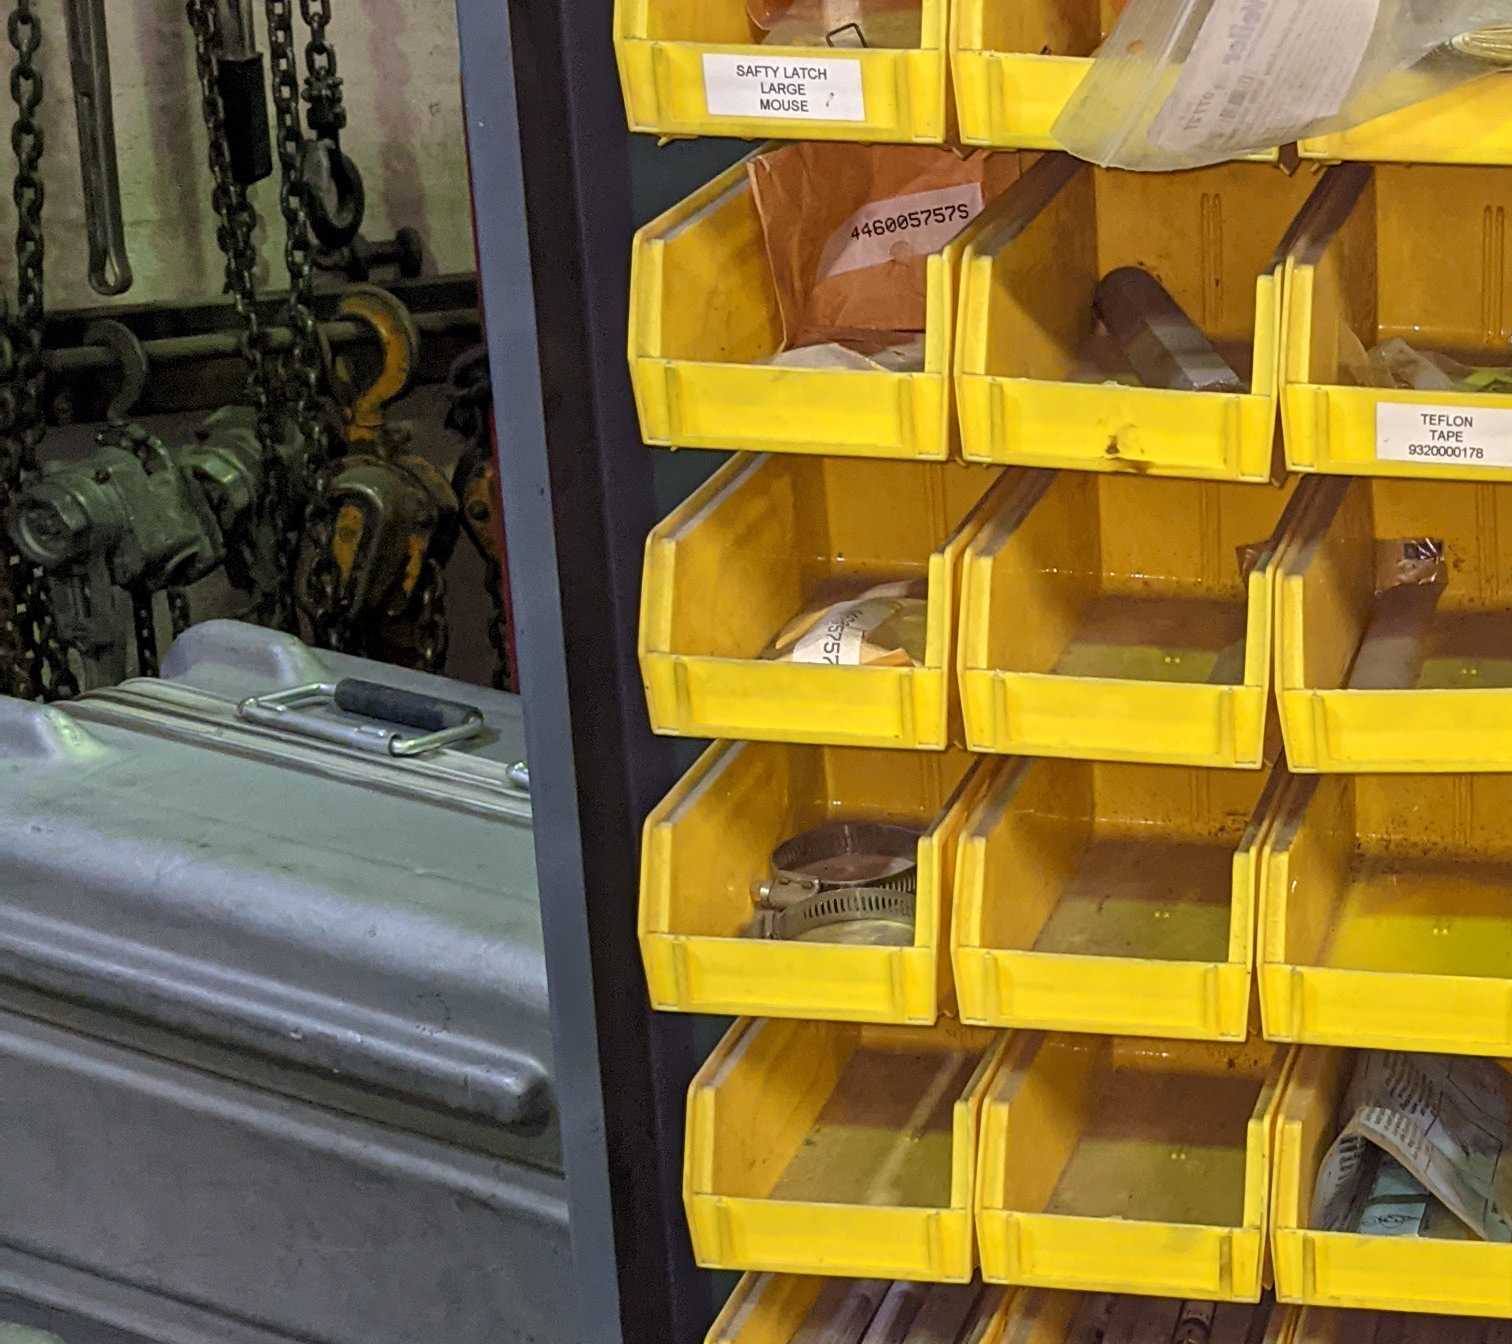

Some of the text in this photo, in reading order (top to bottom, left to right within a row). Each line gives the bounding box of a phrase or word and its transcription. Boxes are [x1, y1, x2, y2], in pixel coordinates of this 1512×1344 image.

[736, 64, 828, 81] SAFTY LATCH
[760, 82, 807, 96] LARGE
[760, 99, 809, 112] MOUSE
[1420, 413, 1473, 427] TEFLON
[1430, 429, 1464, 442] TAPE
[1408, 443, 1484, 459] 9320000178
